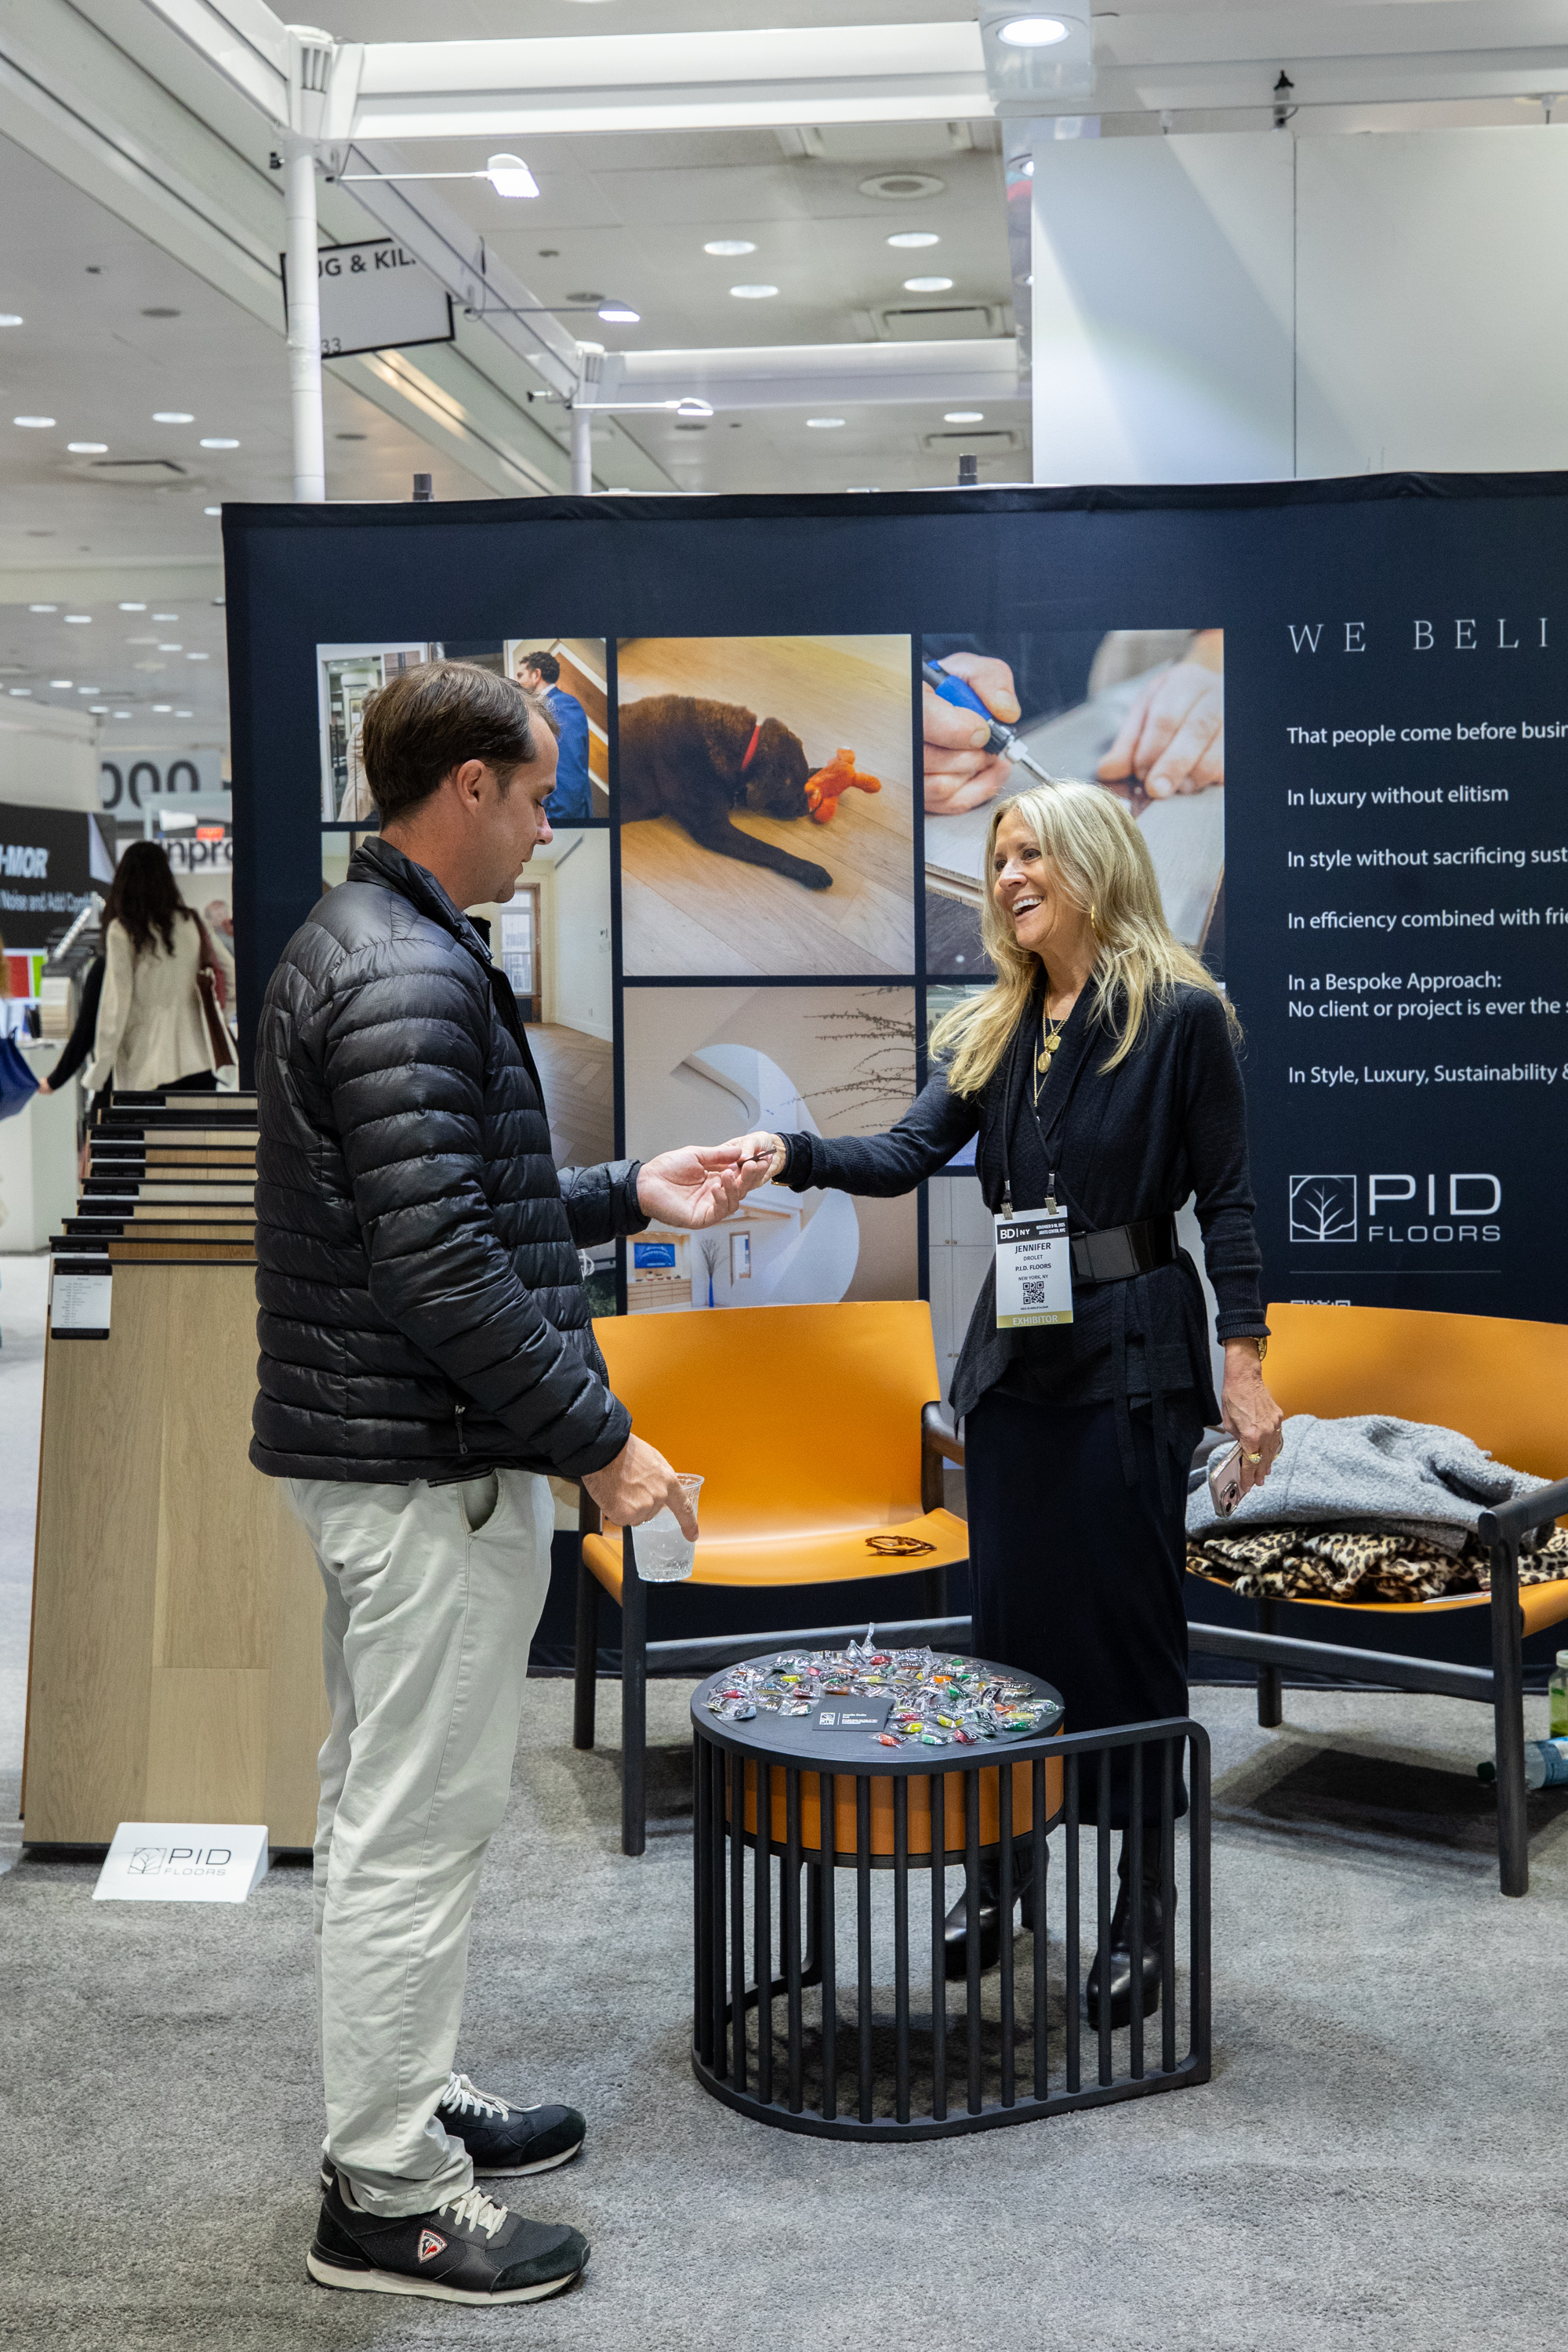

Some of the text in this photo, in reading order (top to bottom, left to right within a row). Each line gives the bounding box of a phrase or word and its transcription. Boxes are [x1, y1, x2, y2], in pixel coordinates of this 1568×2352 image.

[350, 254, 366, 273] &
[374, 248, 417, 270] KIL
[1287, 618, 1548, 653] WE BELI
[1287, 727, 1328, 744] That
[1332, 724, 1396, 747] people
[1400, 727, 1452, 742] come
[1457, 722, 1517, 741] before
[1287, 786, 1509, 809] In luxury without elitism
[1287, 847, 1568, 871] In style without sacrificing sust
[1288, 912, 1305, 929] In
[1309, 911, 1397, 932] efficiency
[1401, 909, 1495, 927] combined
[1499, 908, 1541, 926] with
[1288, 971, 1501, 994] In a Bespoke Approach:
[1288, 1001, 1315, 1018] No
[1319, 1000, 1370, 1018] client
[1373, 1004, 1393, 1017] or
[1397, 1000, 1463, 1021] project
[1467, 999, 1481, 1015] is
[1485, 1002, 1526, 1015] ever
[1530, 997, 1561, 1014] the
[1289, 1067, 1305, 1083] In
[1310, 1065, 1359, 1087] Style,
[1363, 1066, 1429, 1087] Luxury,
[1434, 1063, 1558, 1085] Sustainability
[1369, 1174, 1501, 1216] PID
[1368, 1225, 1501, 1243] FLOORS
[1014, 1242, 1051, 1254] JENNIFER
[1012, 1315, 1058, 1326] EXHIBITOR
[169, 1848, 231, 1865] PID
[164, 1867, 227, 1876] FLOORS
